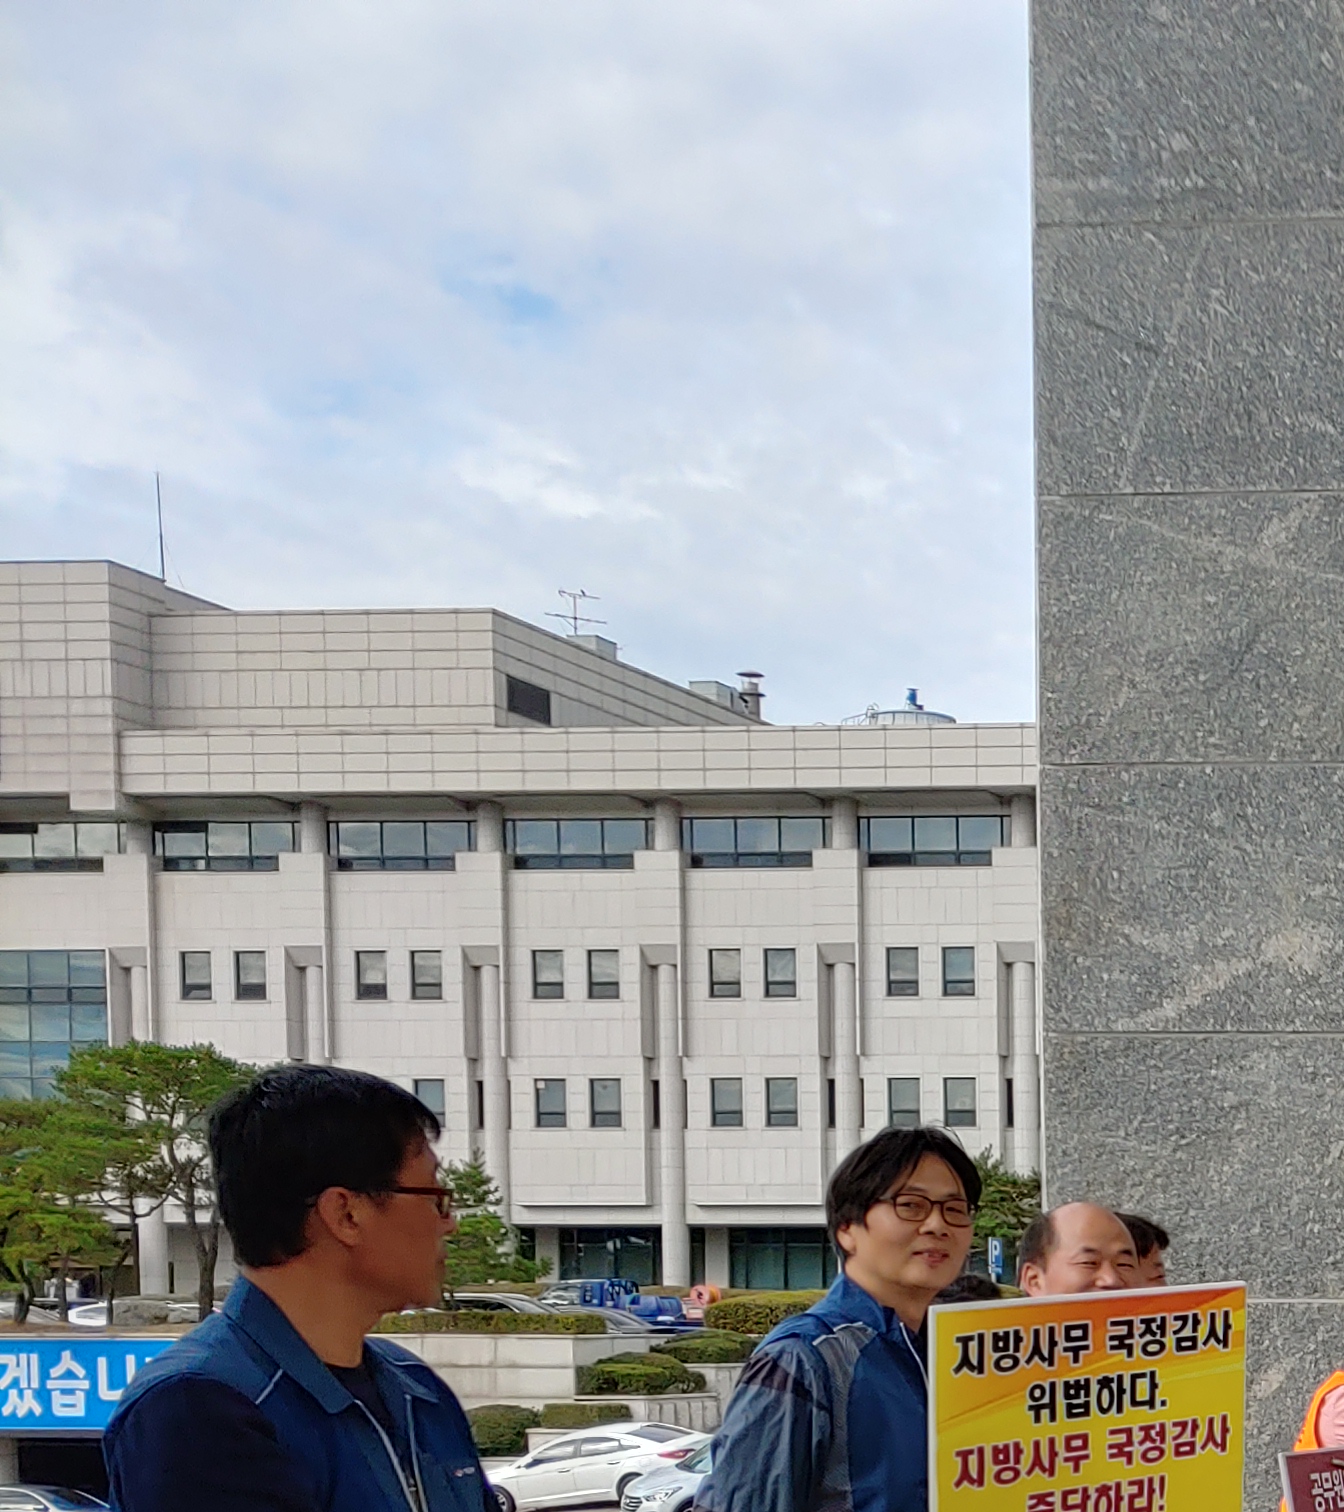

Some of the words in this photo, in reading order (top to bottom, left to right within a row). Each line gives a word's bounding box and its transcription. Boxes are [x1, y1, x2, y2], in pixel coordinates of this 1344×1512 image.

[953, 1321, 1090, 1376] 지방사무
[1107, 1309, 1232, 1359] 국정감사
[0, 1349, 153, 1419] 겠습니
[1027, 1369, 1168, 1425] 위법하다.
[953, 1432, 1091, 1490] 지방사무
[1106, 1413, 1231, 1467] 국정감사
